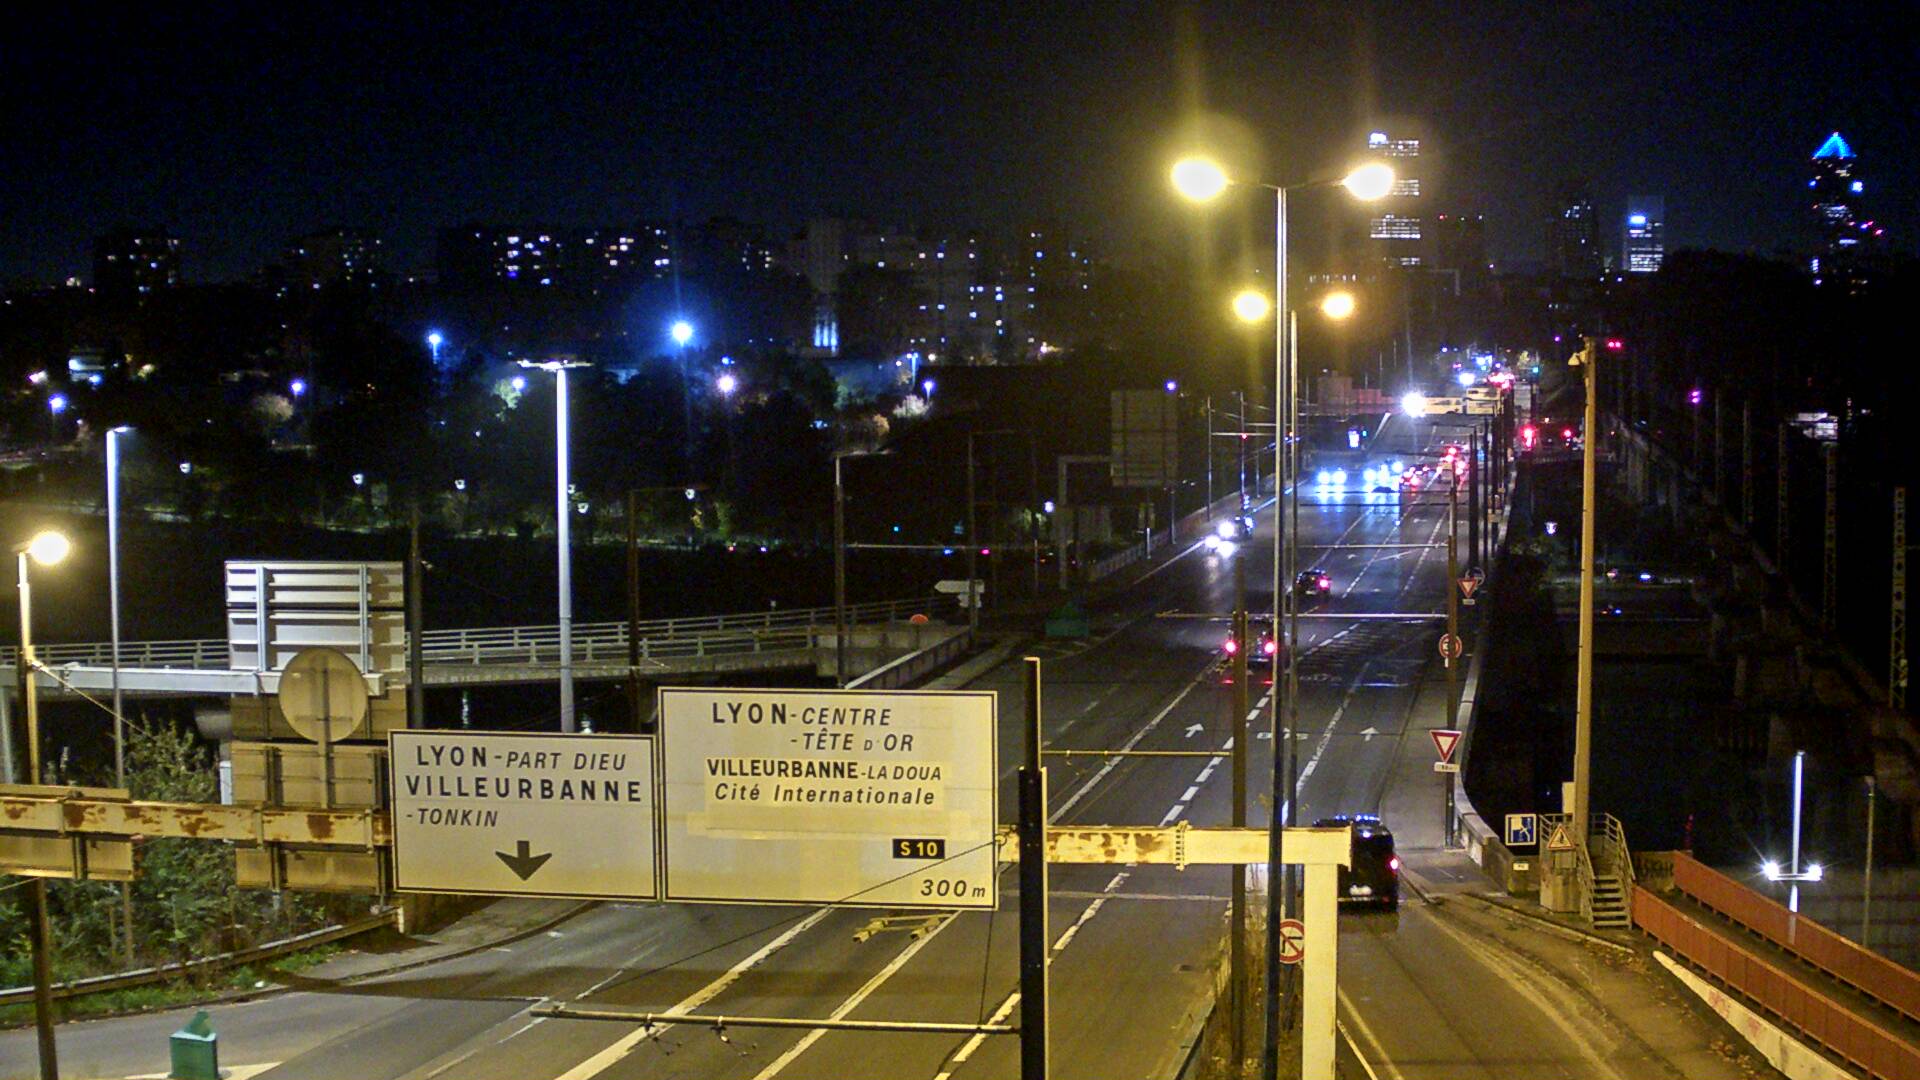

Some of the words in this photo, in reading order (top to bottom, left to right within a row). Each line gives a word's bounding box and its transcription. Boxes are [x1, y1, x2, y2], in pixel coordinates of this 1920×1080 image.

[712, 702, 891, 726] LYON-CENTRE
[573, 752, 626, 771] DIEU
[892, 765, 942, 782] DOUA
[404, 775, 641, 803] VILLEURBANNE
[714, 782, 761, 801] Cité
[774, 784, 935, 805] Internationale
[406, 807, 498, 828] -TONKIN
[920, 878, 967, 898] 300
[971, 887, 986, 898] m
